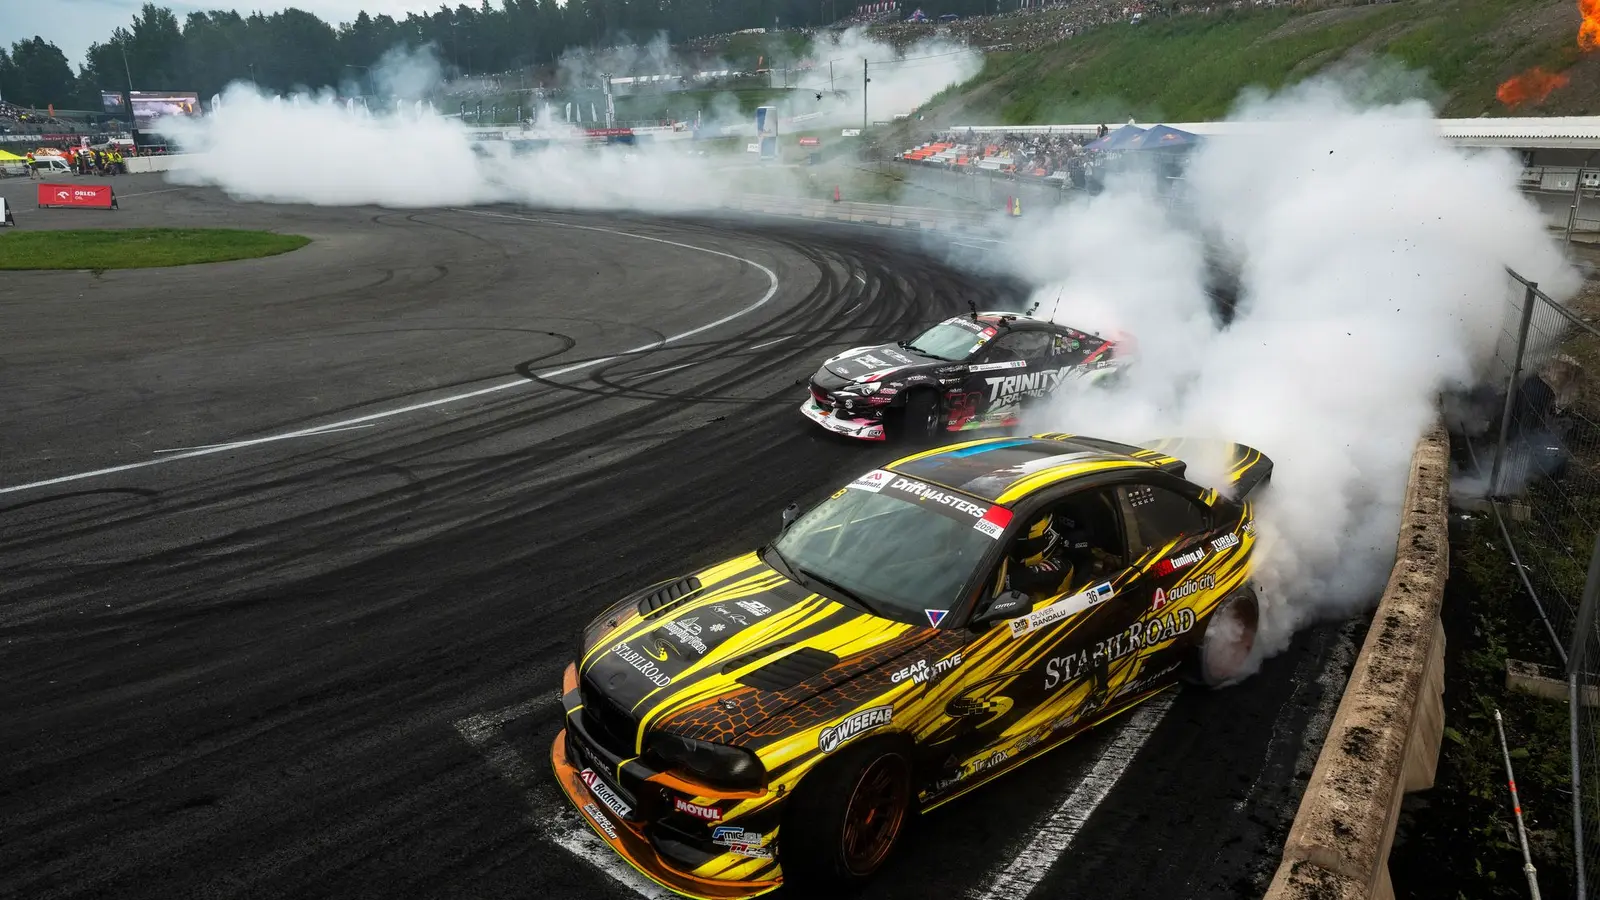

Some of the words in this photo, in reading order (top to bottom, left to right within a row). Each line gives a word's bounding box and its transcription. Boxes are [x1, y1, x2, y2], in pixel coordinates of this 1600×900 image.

[984, 365, 1072, 403] TRINITY
[975, 520, 996, 535] 2026
[1086, 590, 1098, 605] 36
[1169, 578, 1198, 601] audio
[1199, 573, 1216, 589] city
[1030, 607, 1055, 621] OLIVER
[1032, 609, 1066, 628] RANDALU
[1044, 608, 1196, 691] STABILROAD
[611, 642, 671, 688] STABILROAD
[890, 659, 927, 683] GEAR
[912, 653, 962, 684] MOTIVE
[837, 708, 893, 740] WISEFAB
[676, 800, 720, 819] MOTUL
